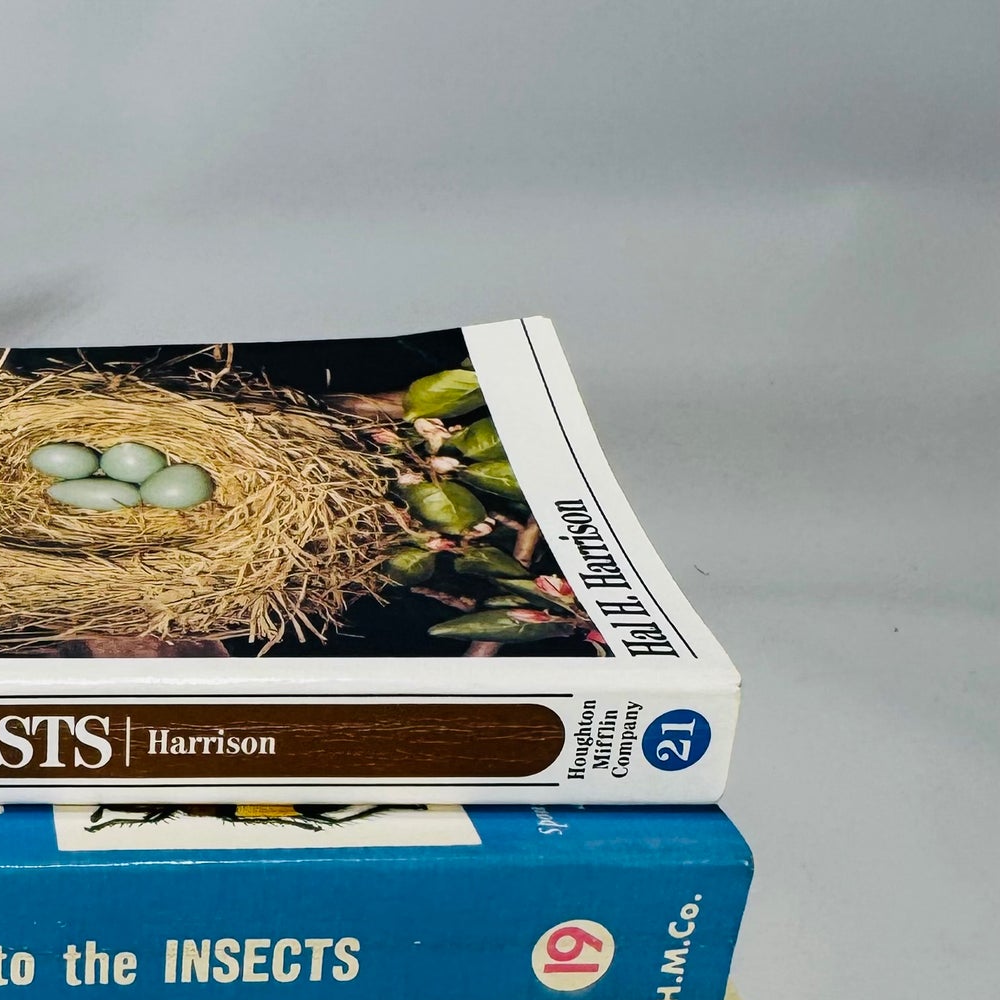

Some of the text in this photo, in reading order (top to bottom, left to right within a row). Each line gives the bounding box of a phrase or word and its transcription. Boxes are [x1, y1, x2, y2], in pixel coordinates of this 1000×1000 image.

[554, 498, 680, 658] Hal H. Harrison
[147, 729, 276, 756] Harrison
[567, 699, 597, 780] Houghton
[592, 709, 619, 770] Mifflin
[611, 701, 643, 779] Company
[656, 718, 697, 762] 21
[63, 940, 137, 987] the
[164, 937, 361, 984] INSECTS
[543, 926, 603, 974] 19
